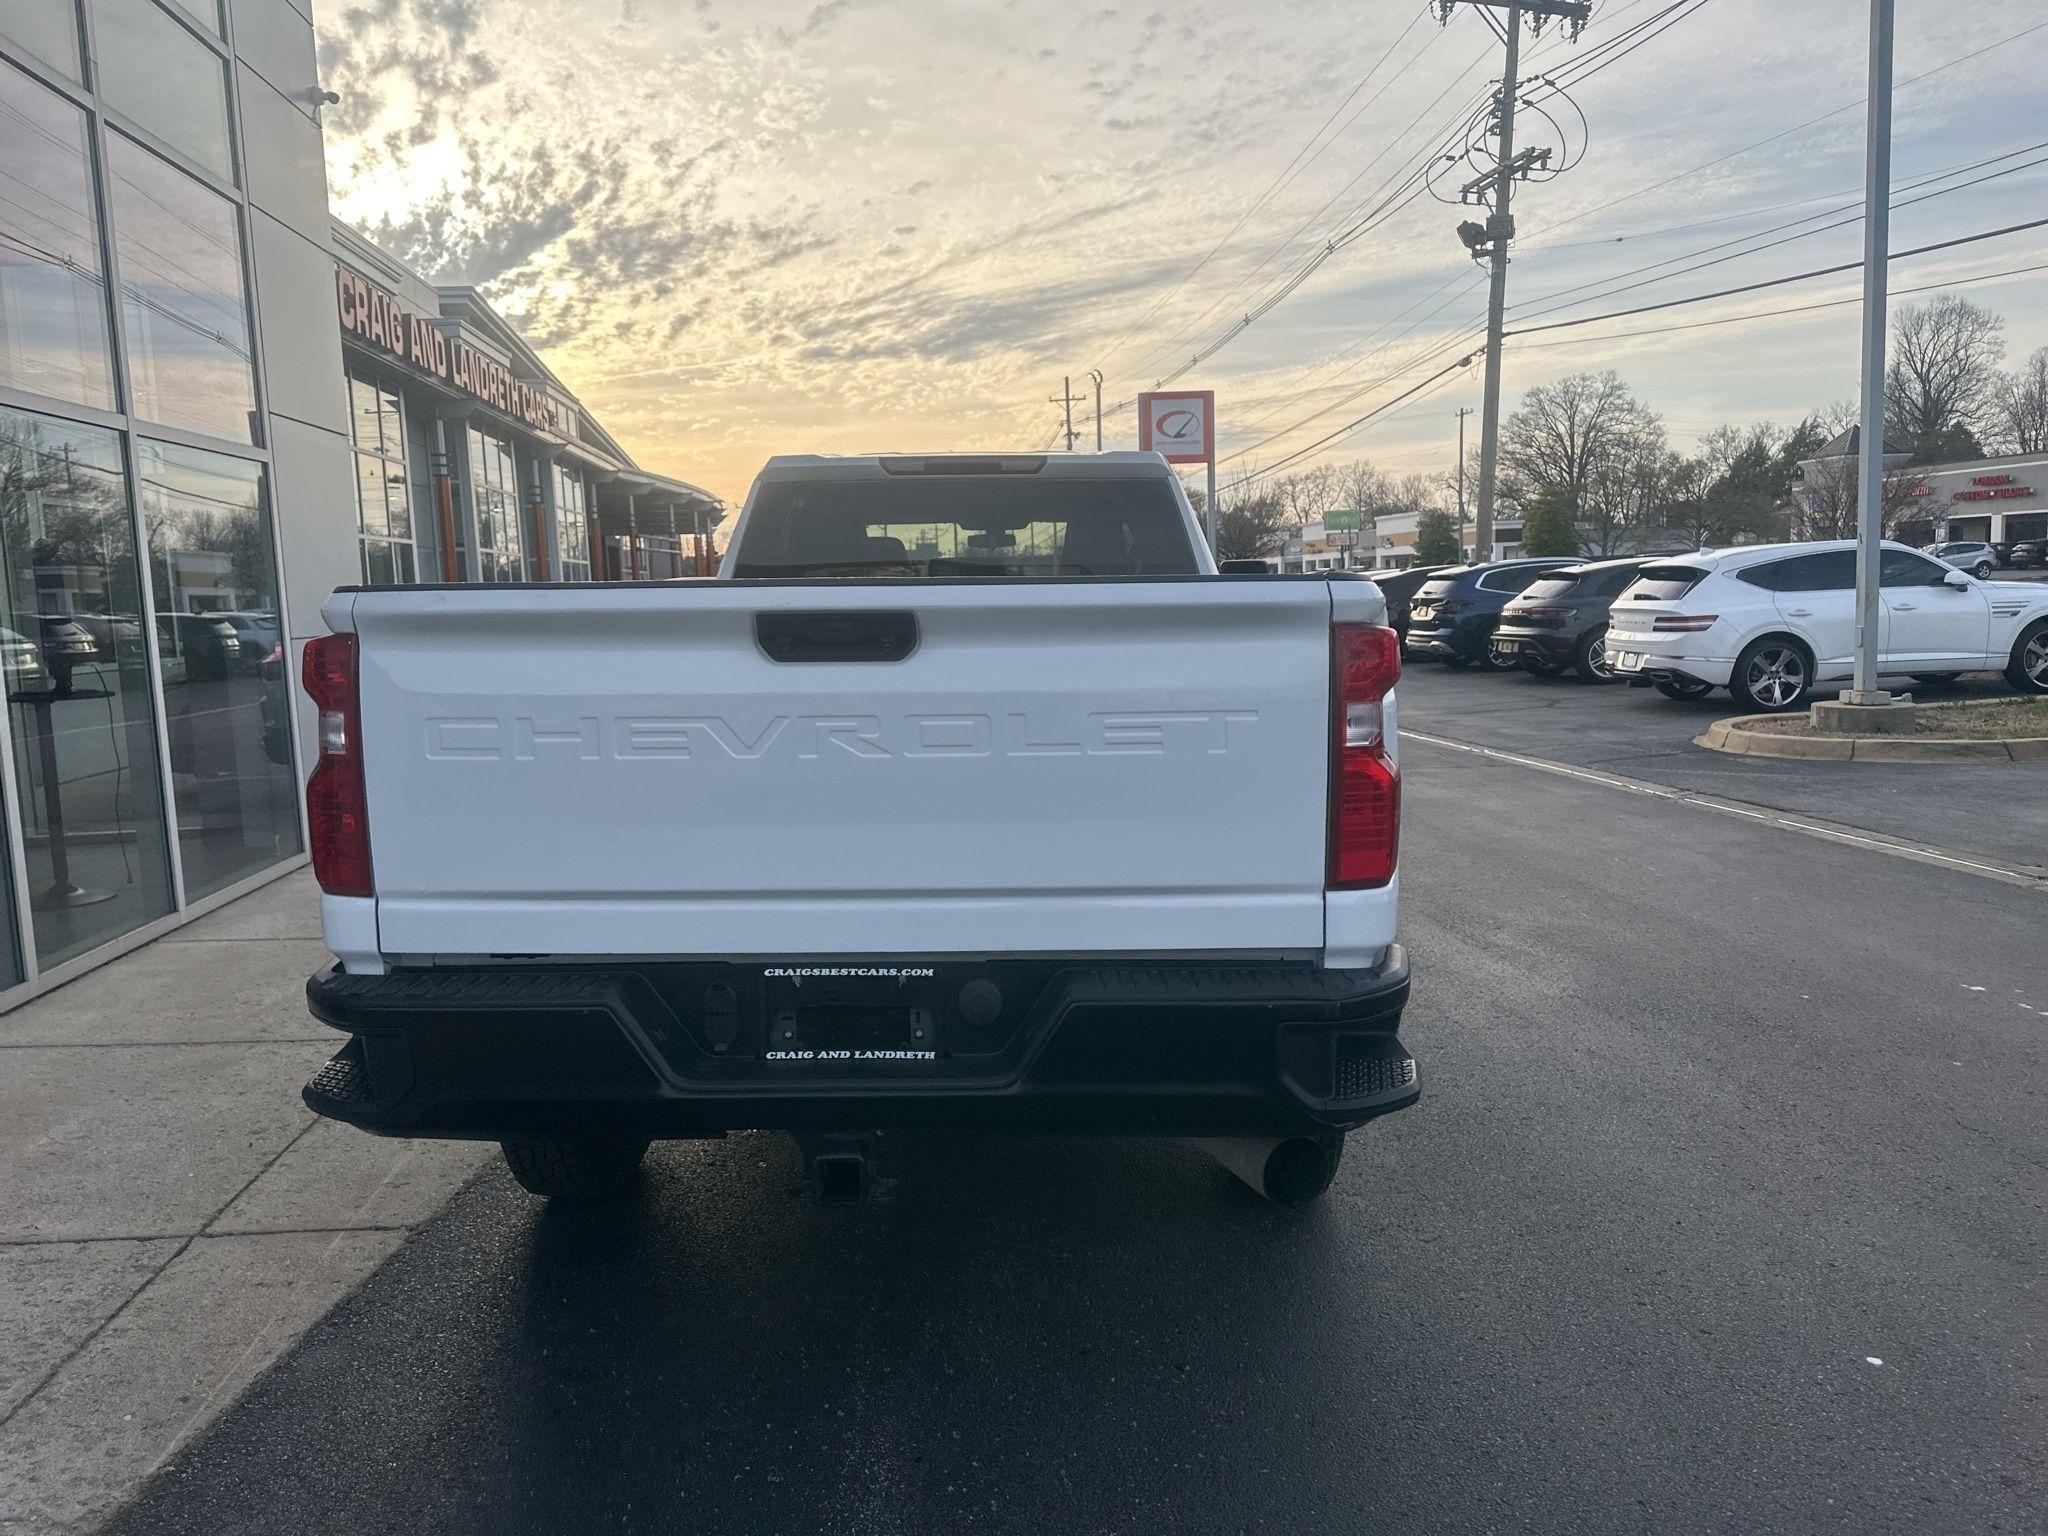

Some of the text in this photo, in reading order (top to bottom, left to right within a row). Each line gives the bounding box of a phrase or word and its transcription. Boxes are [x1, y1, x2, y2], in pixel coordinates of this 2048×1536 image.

[337, 268, 551, 432] CRAIG AND LANDRETH CARS
[425, 709, 1260, 761] CHEVROLET
[763, 967, 935, 977] CRAIGSBESTCARS.COM
[766, 1050, 936, 1060] CRAIG AND LANDRETH
